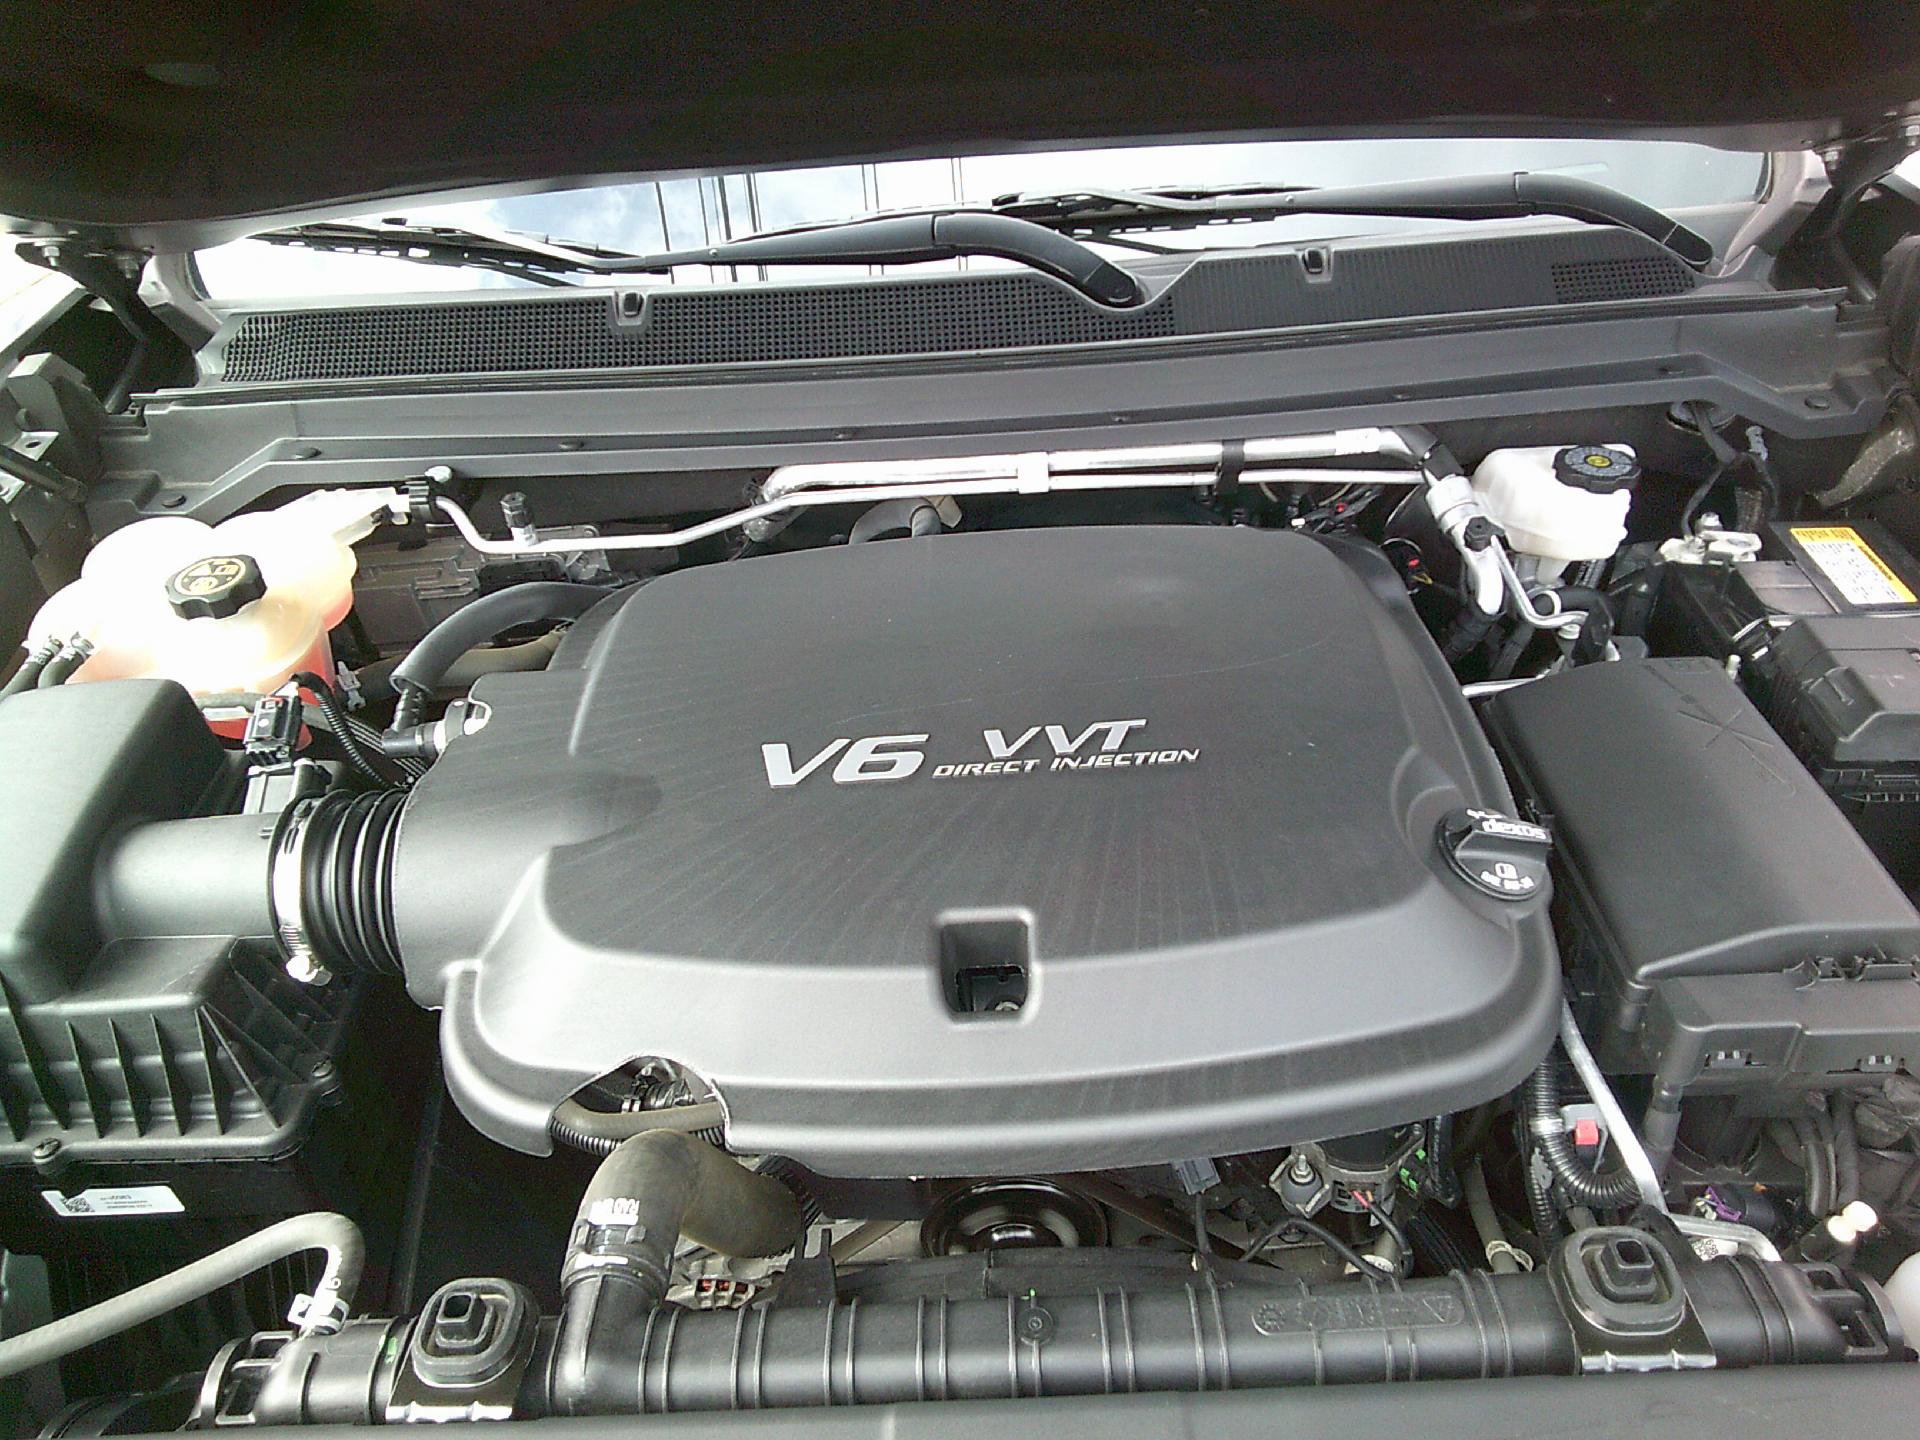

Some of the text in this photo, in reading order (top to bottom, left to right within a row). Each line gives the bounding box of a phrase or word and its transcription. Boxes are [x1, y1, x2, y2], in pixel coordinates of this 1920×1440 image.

[761, 719, 1147, 788] V6 VVT
[931, 748, 1200, 779] DIRECT INJECTION
